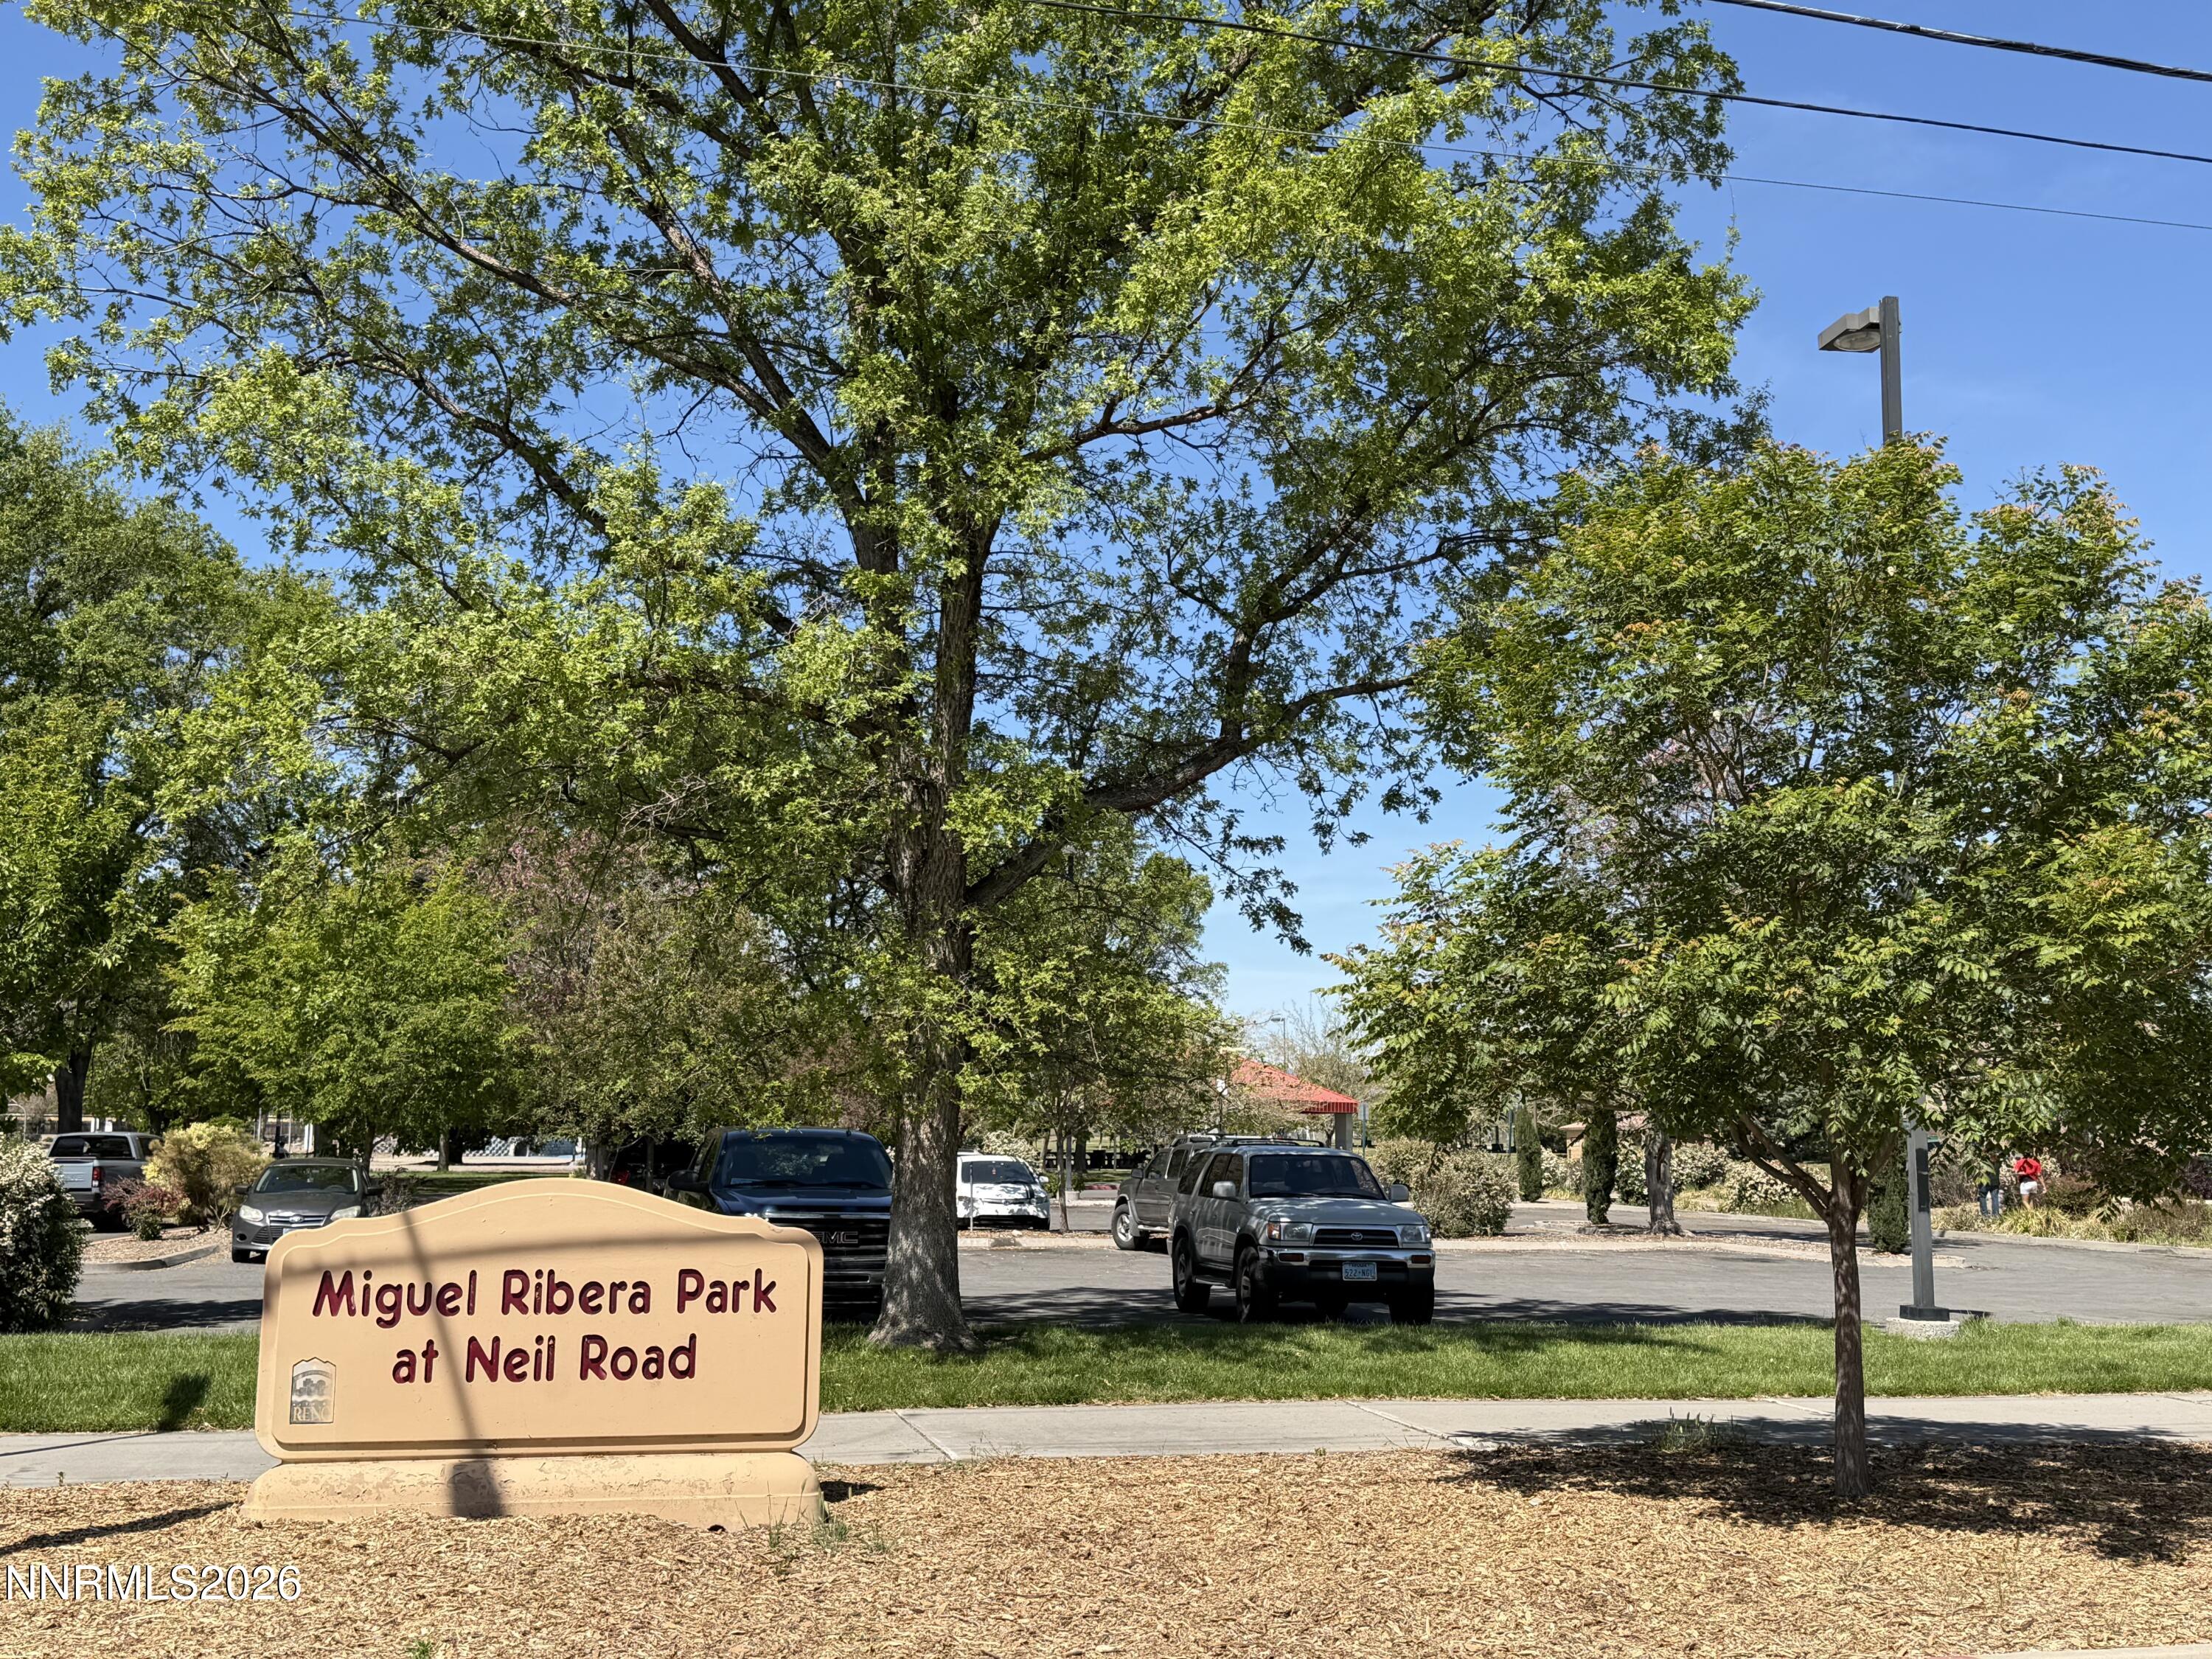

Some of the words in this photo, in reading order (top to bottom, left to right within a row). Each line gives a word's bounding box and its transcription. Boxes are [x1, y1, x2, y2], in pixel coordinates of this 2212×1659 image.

[313, 1269, 477, 1329] Miguel
[501, 1268, 651, 1315] Ribera
[677, 1267, 777, 1314] Park
[392, 1339, 439, 1384] at
[466, 1335, 556, 1383] Neil
[580, 1332, 698, 1381] Road
